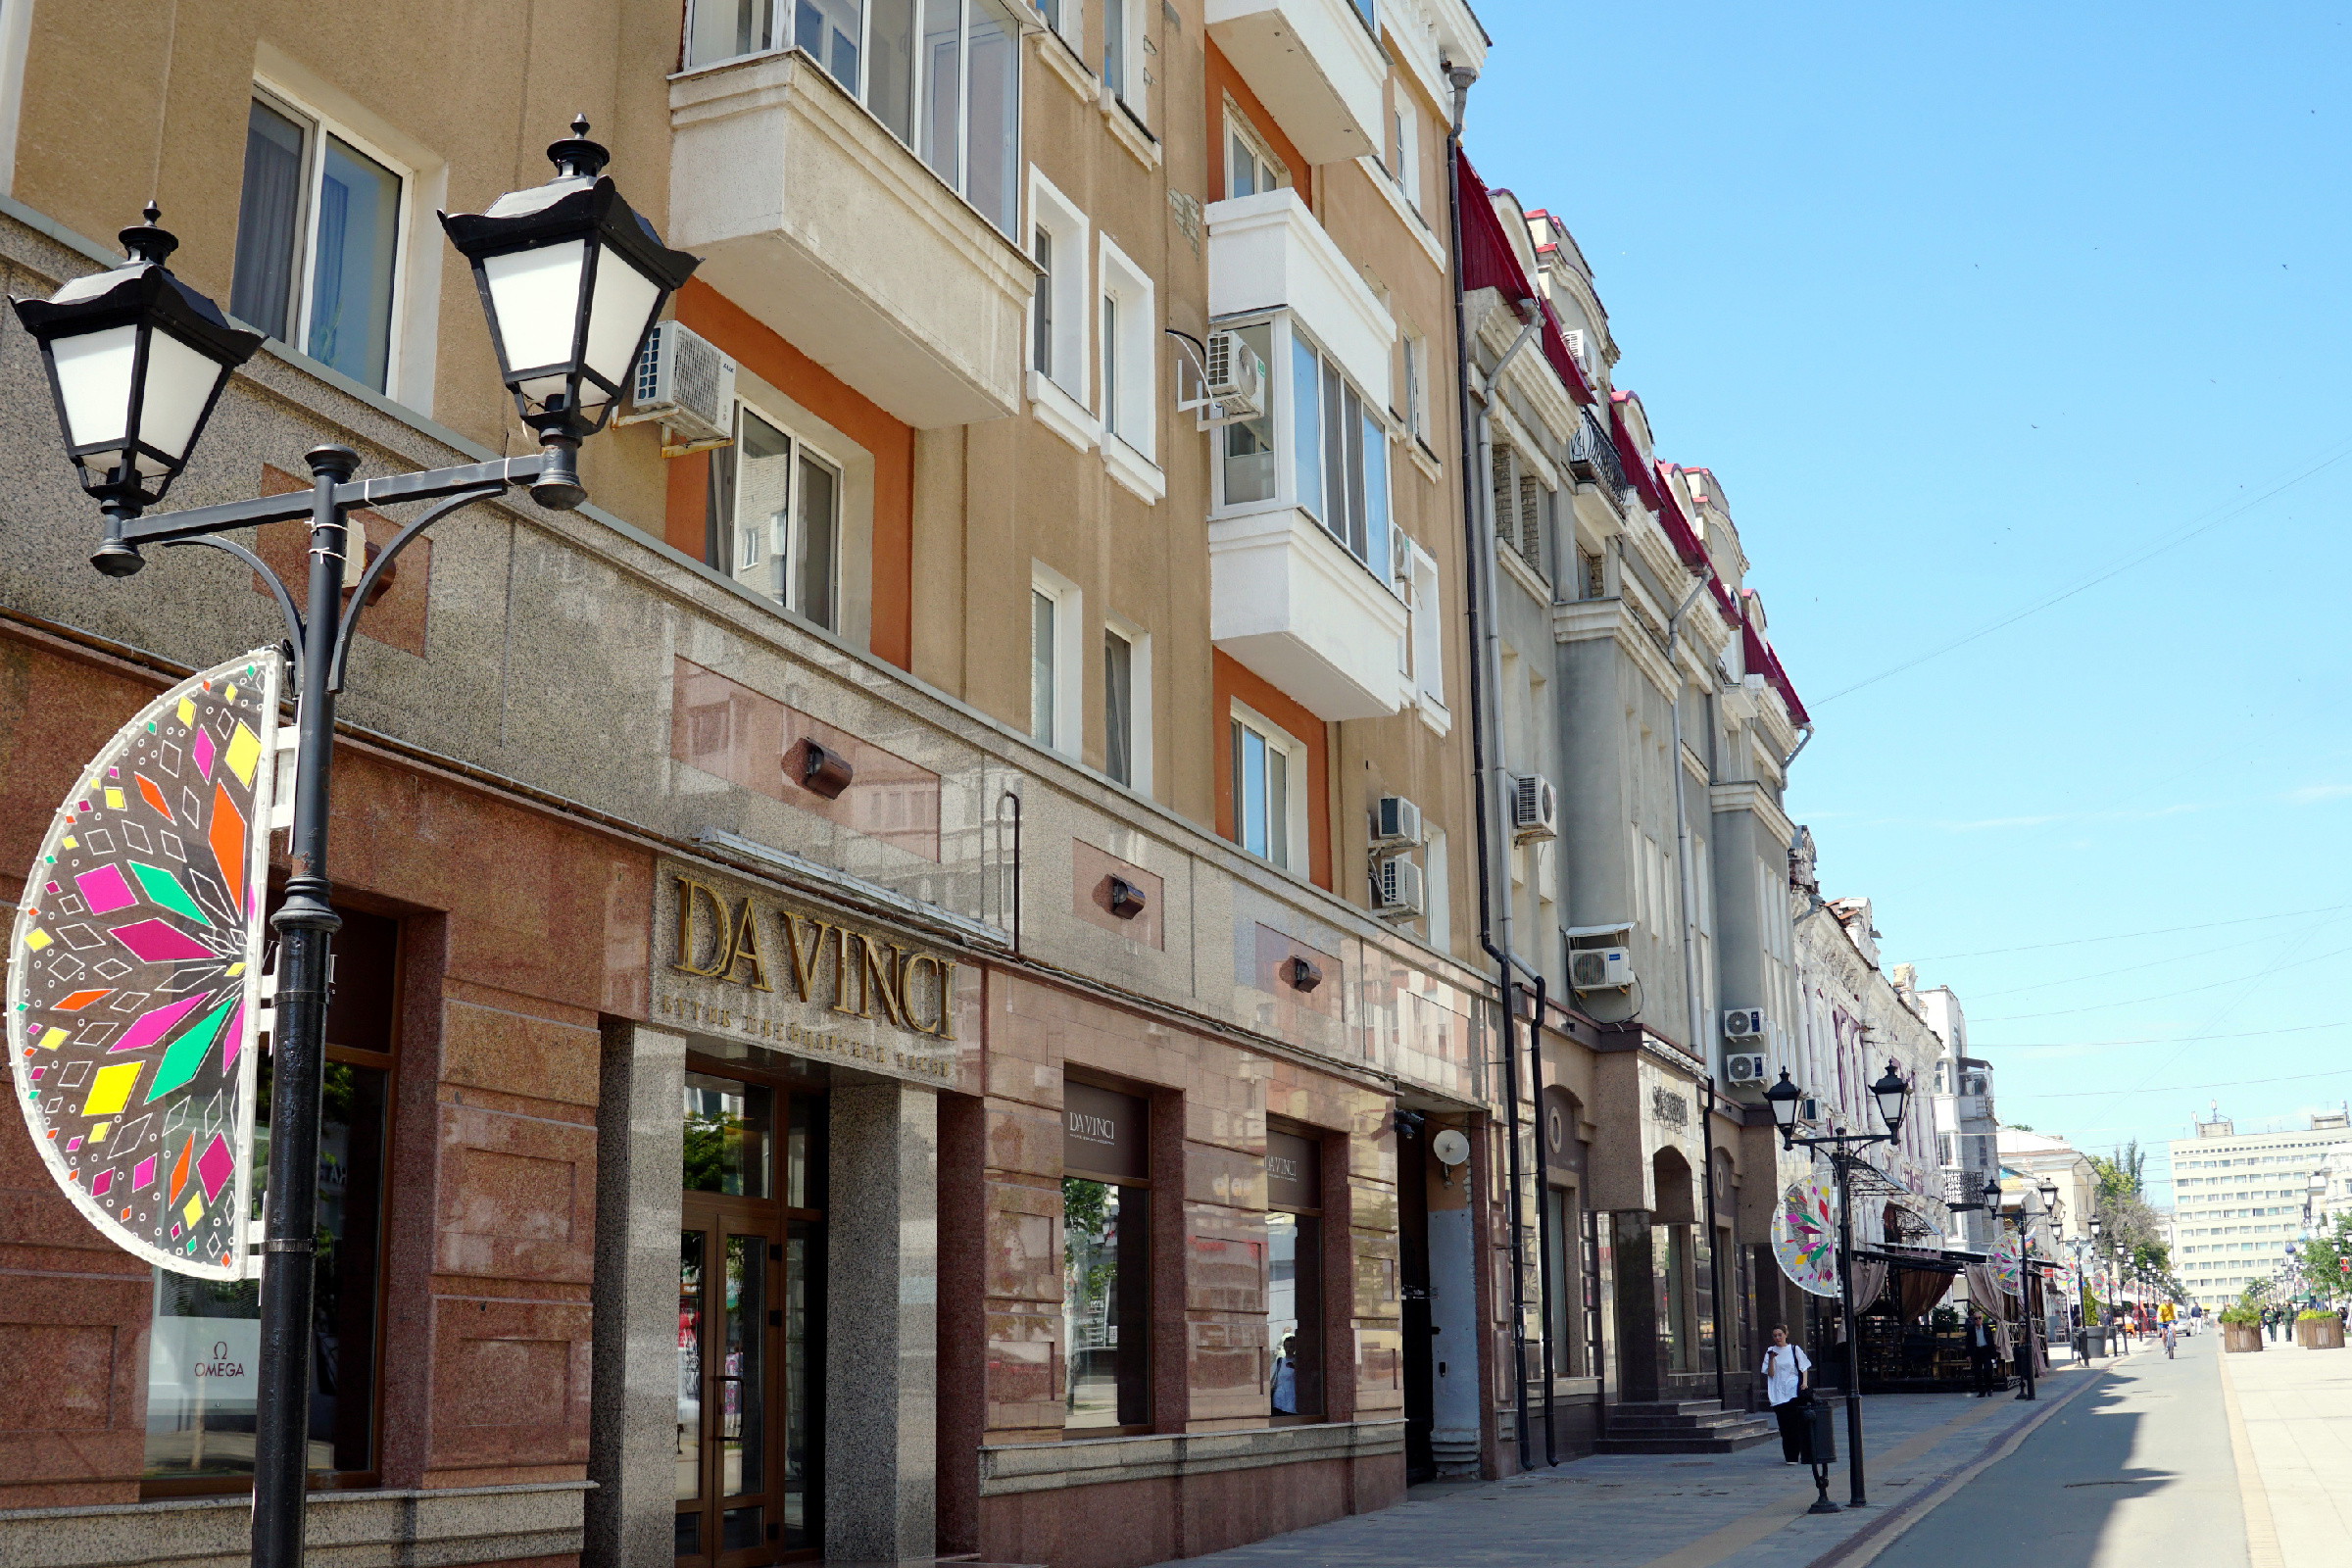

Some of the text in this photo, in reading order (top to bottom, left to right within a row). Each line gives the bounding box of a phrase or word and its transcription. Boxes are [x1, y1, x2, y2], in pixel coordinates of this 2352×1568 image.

[672, 876, 957, 1041] DA VINCI
[662, 995, 950, 1078] БУТИК ШВЕЙЦАРСКИХ ЧАСОВ
[1069, 1111, 1084, 1134] DA
[1084, 1114, 1114, 1140] VINCI
[1275, 1156, 1297, 1177] VINCI
[194, 1362, 245, 1377] OMEGA
